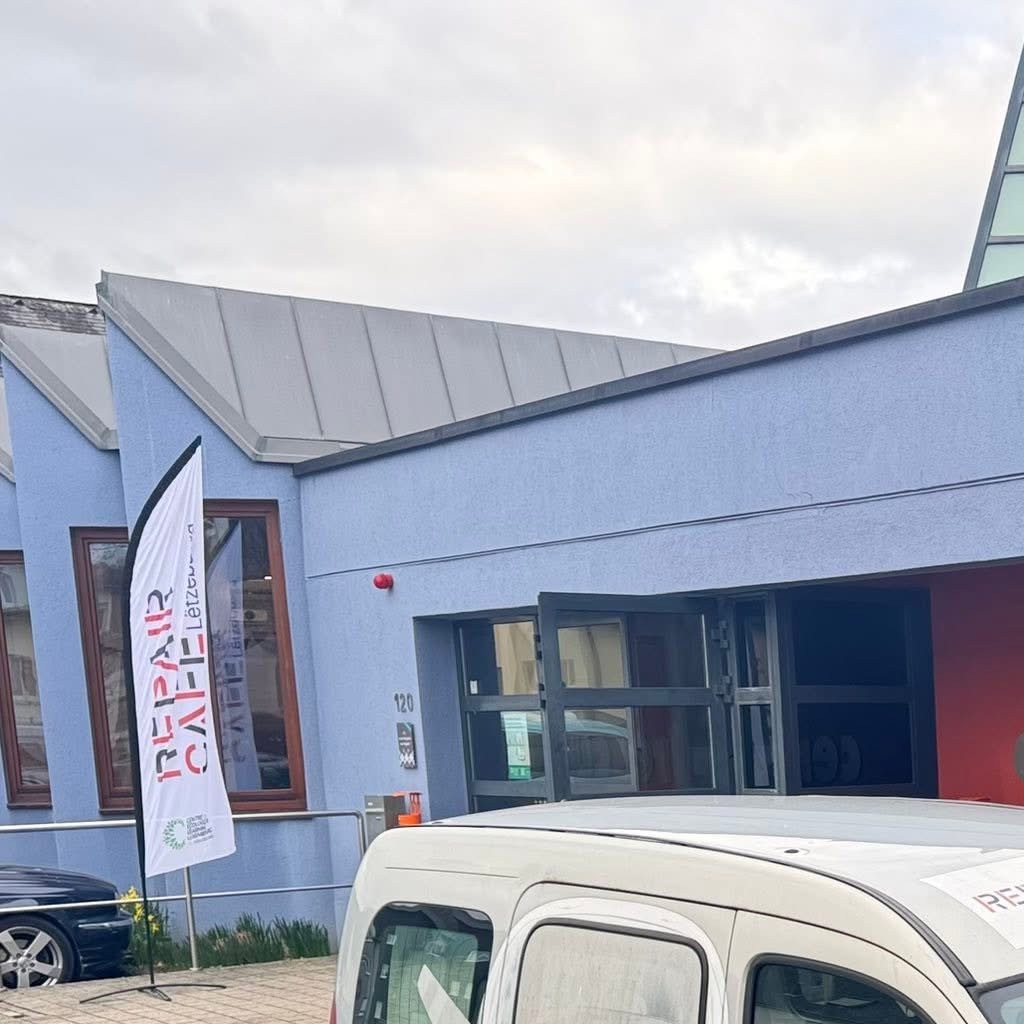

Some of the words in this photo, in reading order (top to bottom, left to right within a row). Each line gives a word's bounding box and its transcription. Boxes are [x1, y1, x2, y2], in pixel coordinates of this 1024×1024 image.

[144, 587, 182, 782] REPAIR
[176, 633, 207, 773] CAFE
[394, 693, 413, 713] 120
